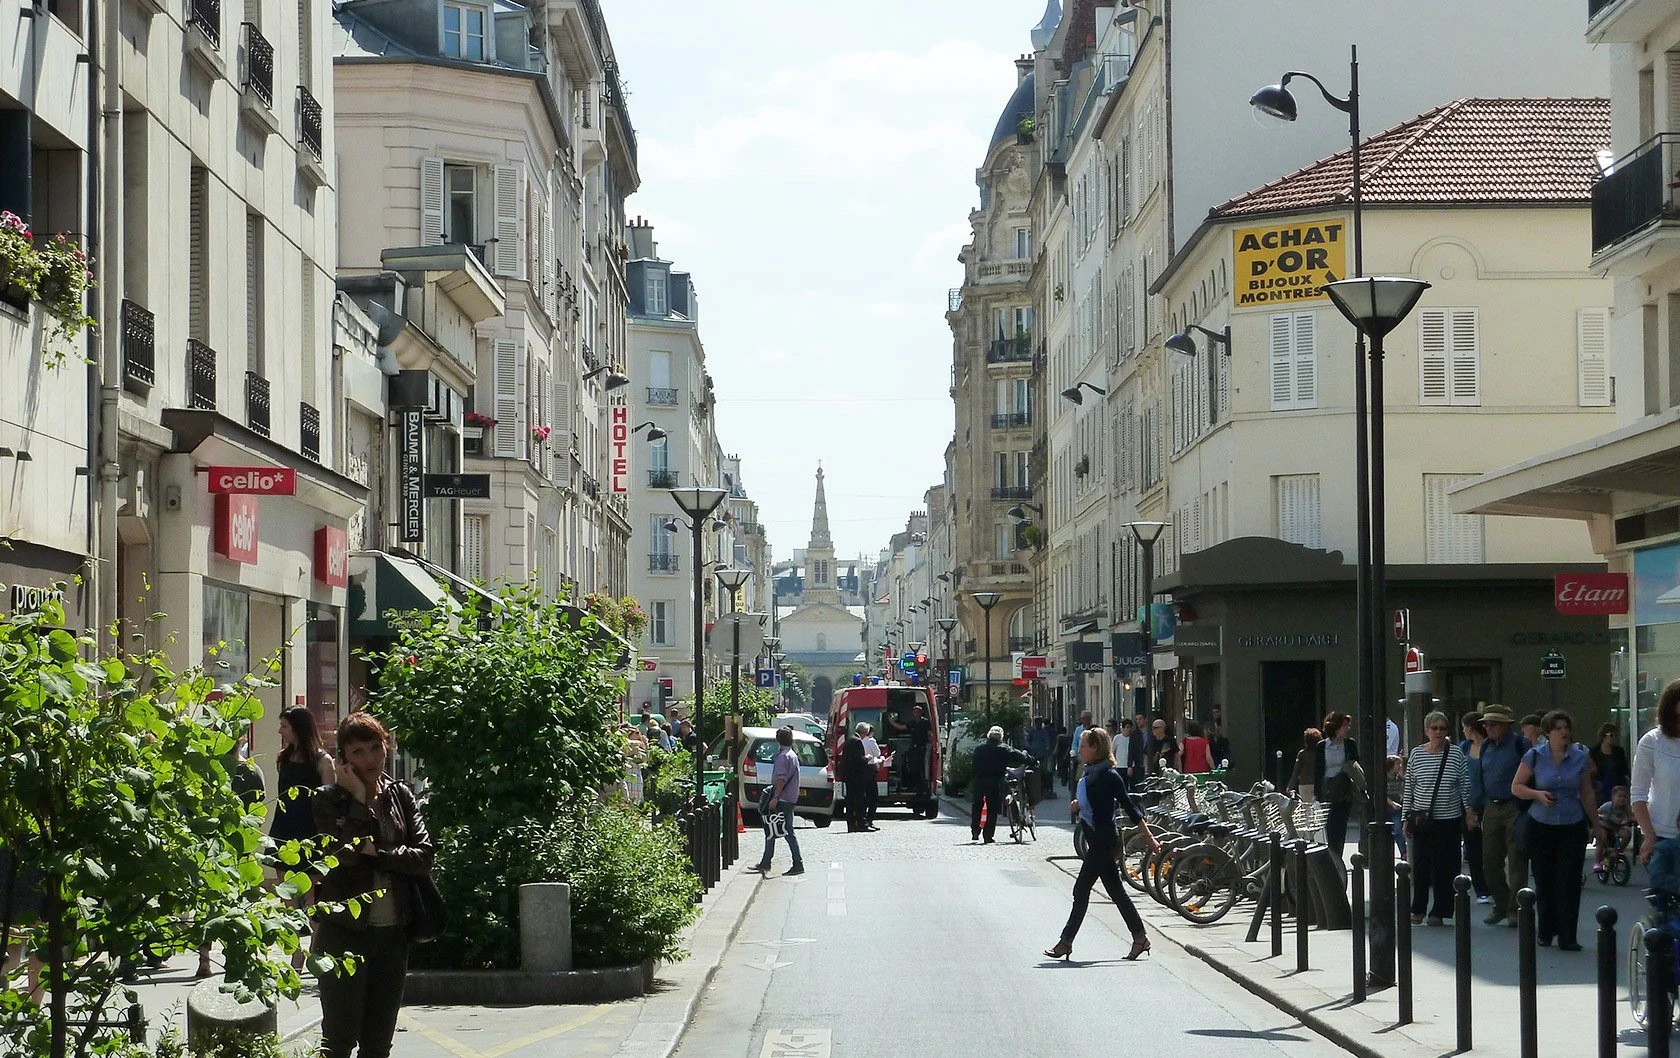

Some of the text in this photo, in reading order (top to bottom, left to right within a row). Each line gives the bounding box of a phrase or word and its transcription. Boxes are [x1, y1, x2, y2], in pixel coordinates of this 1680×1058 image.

[1238, 224, 1342, 253] ACHAT
[1251, 247, 1330, 277] D'OR
[1240, 286, 1324, 304] MONTRES
[1249, 274, 1313, 291] BIJOUX
[613, 407, 627, 492] HOTEL
[408, 411, 420, 538] BAUME & MERCIER
[1558, 580, 1625, 602] Etam
[761, 672, 770, 685] P
